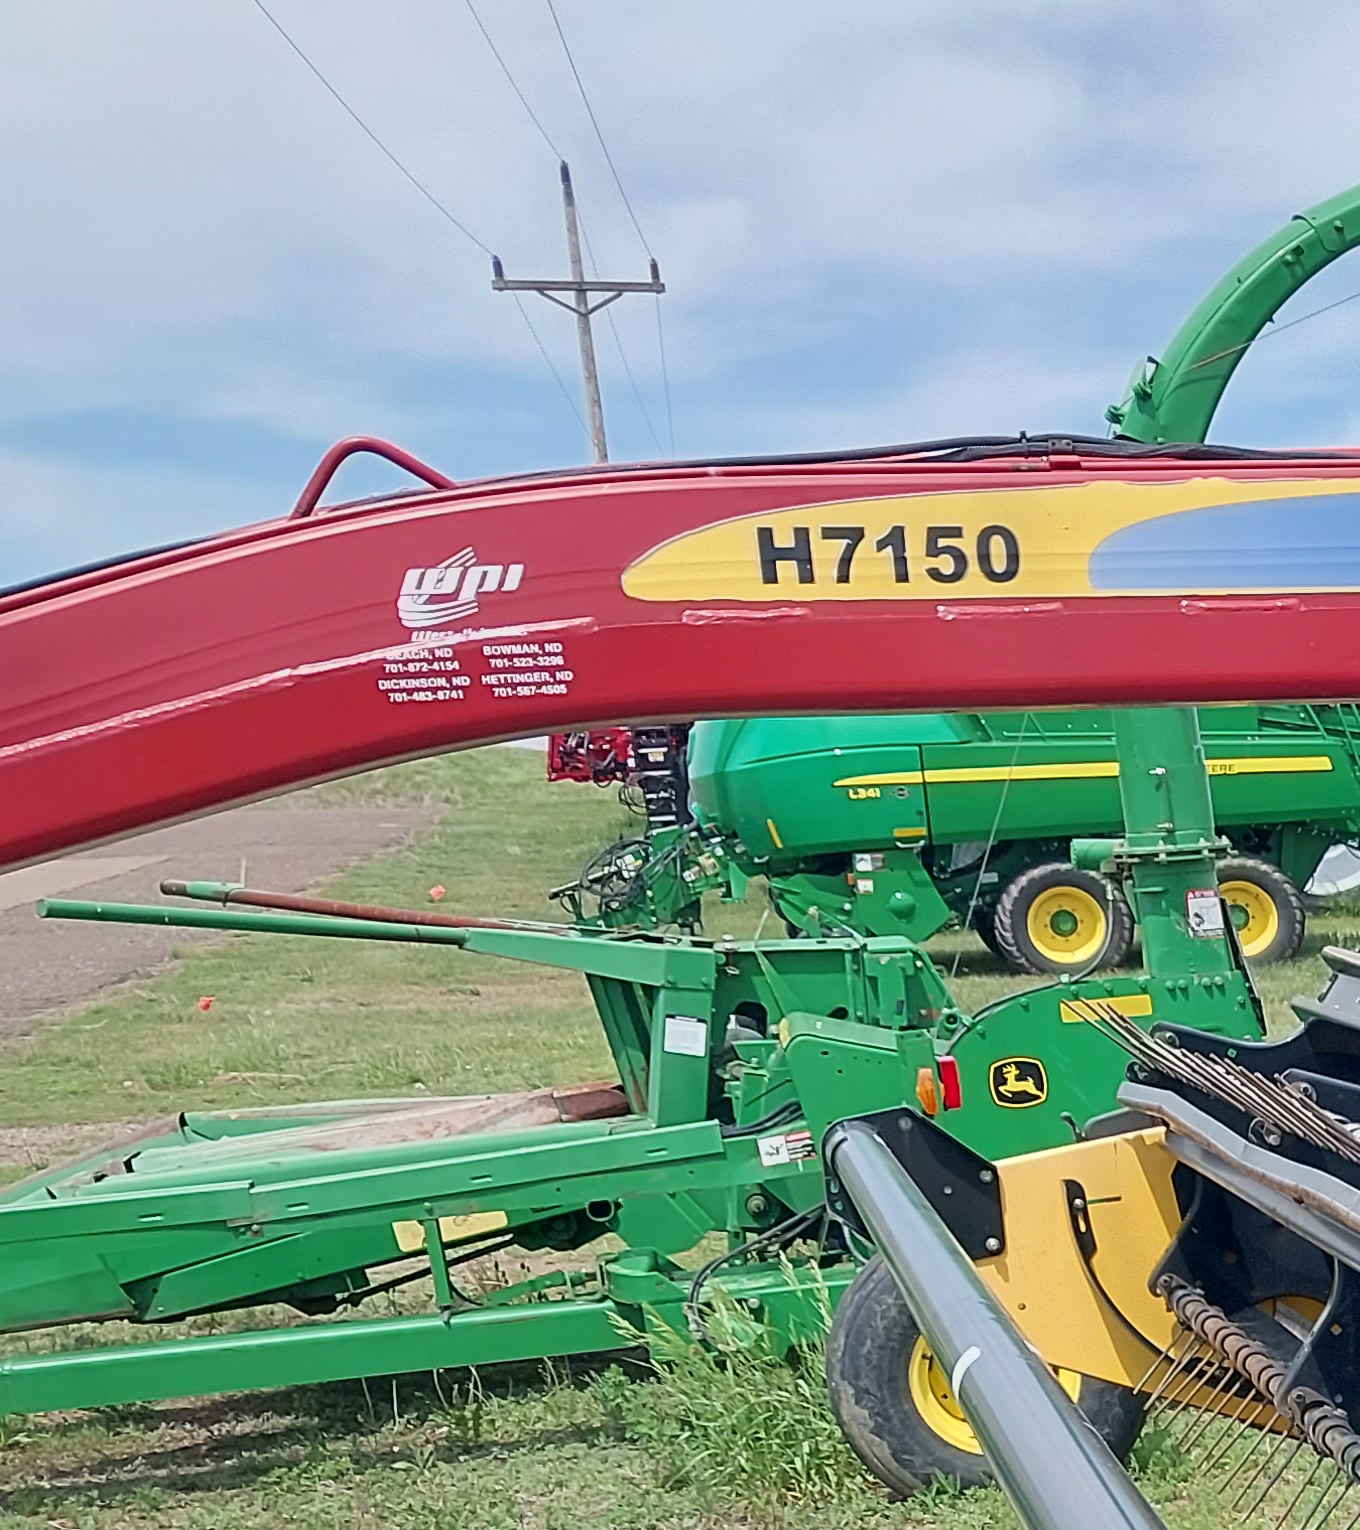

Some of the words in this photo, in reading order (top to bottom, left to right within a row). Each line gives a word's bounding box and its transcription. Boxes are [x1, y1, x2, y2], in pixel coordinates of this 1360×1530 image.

[756, 525, 1021, 584] H7150
[434, 647, 453, 658] ND
[482, 643, 542, 656] BOWMAN,
[544, 642, 563, 653] ND
[378, 677, 450, 690] DICKINSON,
[451, 675, 471, 687] ND
[481, 671, 554, 685] HETTINGER,
[555, 670, 574, 682] ND
